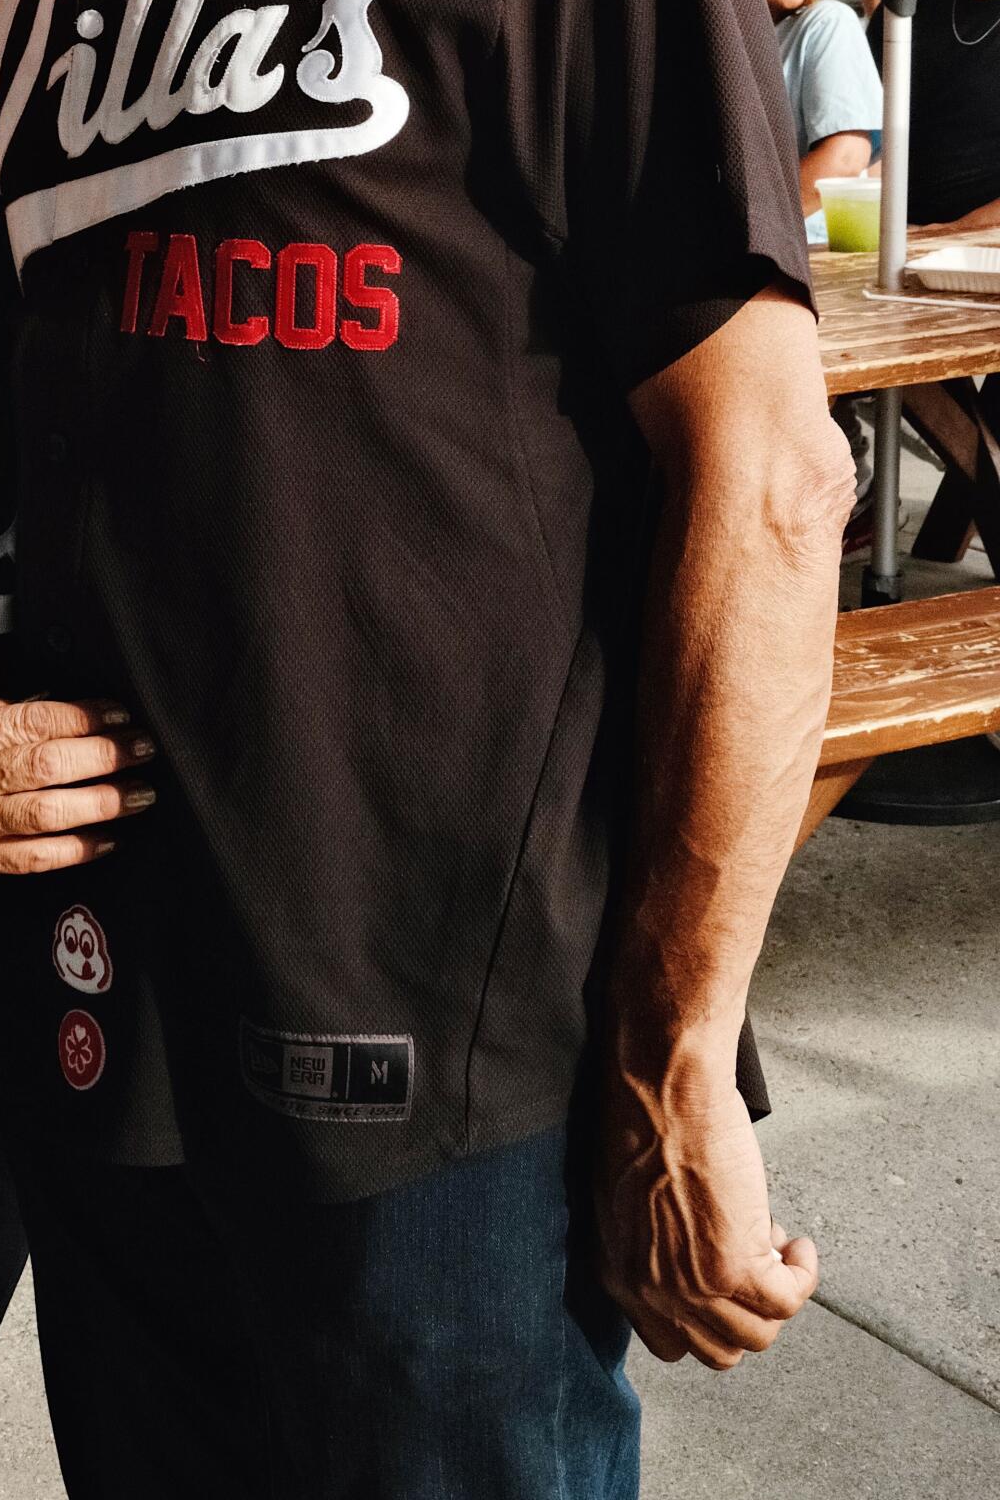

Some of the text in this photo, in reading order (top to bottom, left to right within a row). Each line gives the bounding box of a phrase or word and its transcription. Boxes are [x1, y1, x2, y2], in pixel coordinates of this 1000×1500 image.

[120, 231, 403, 351] TACOS
[289, 1056, 326, 1071] NEW
[289, 1070, 326, 1086] ERA
[370, 1060, 389, 1085] M
[318, 1104, 363, 1116] SINCE
[368, 1105, 406, 1116] 1920
